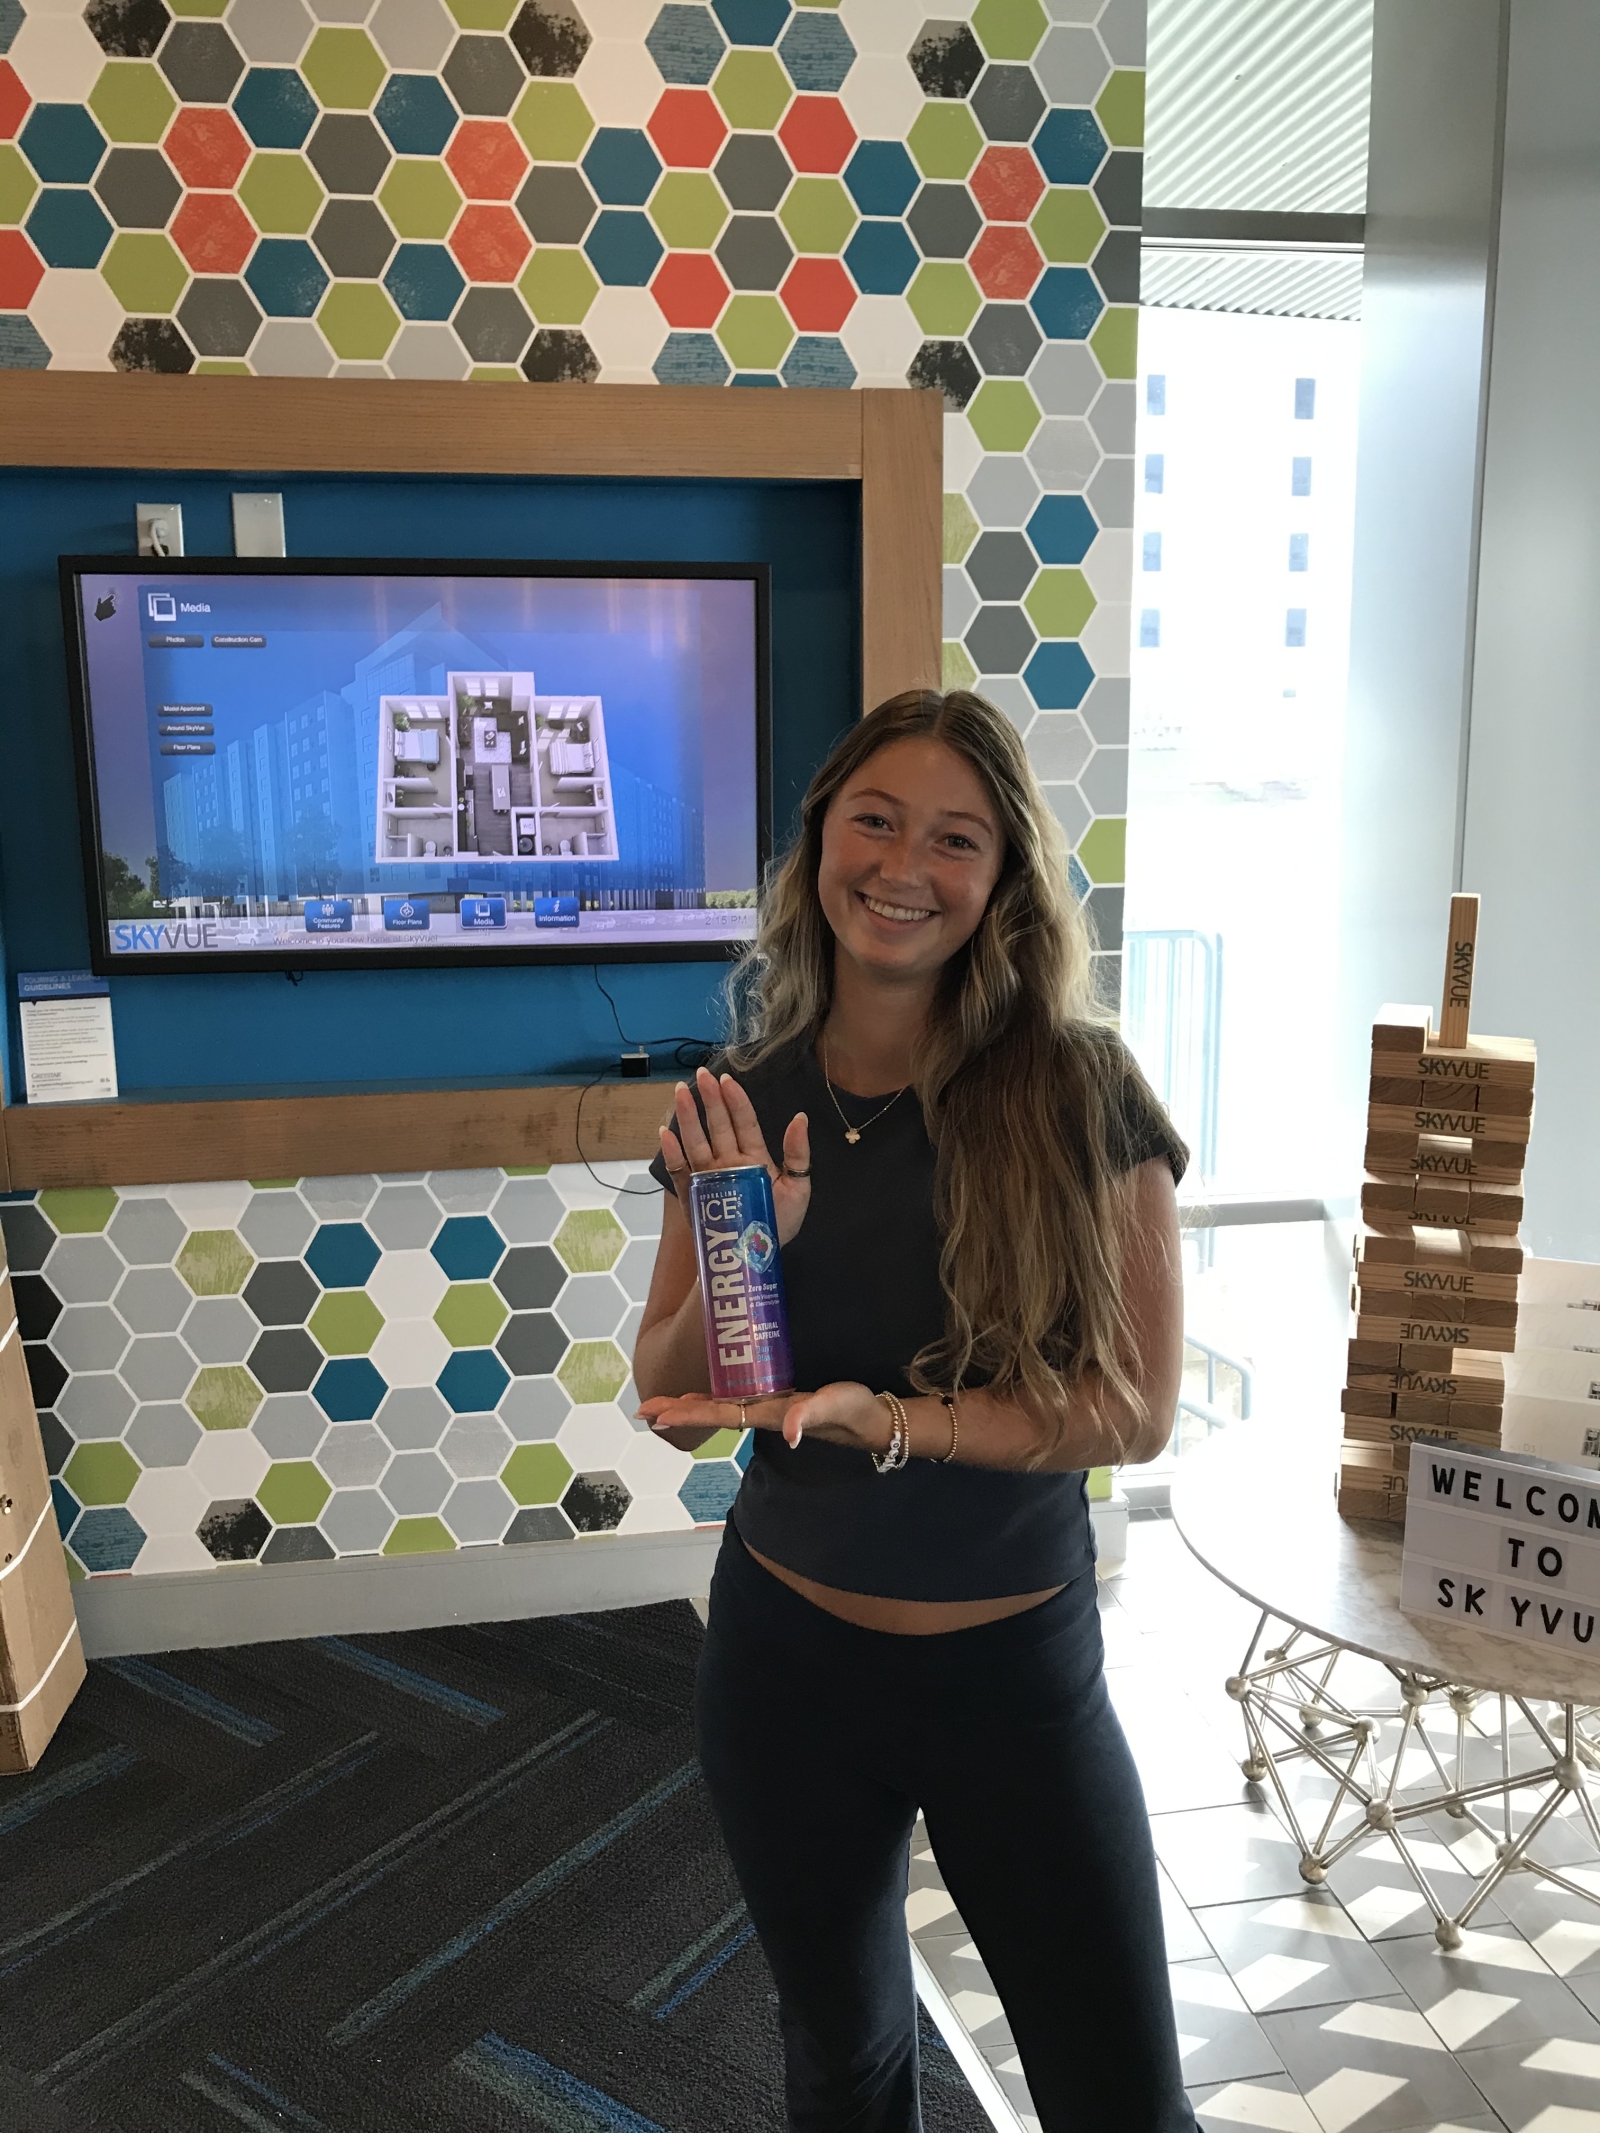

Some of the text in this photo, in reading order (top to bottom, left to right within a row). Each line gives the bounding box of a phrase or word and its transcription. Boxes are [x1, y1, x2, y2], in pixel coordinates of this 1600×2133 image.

[180, 603, 211, 613] Media
[731, 915, 747, 925] PM
[115, 924, 218, 950] SKYVUE
[273, 937, 313, 946] Welcome
[316, 936, 324, 944] to
[326, 936, 345, 945] your
[367, 934, 391, 944] home
[1449, 941, 1473, 1008] SKYVUE
[24, 982, 72, 992] GUIDELINES
[1417, 1057, 1491, 1080] SKYVUE
[1414, 1111, 1486, 1134] SKYVUE
[700, 1196, 738, 1222] ICE
[748, 1283, 778, 1292] Zero Sugar
[1403, 1271, 1474, 1293] SKYVUE
[705, 1227, 753, 1367] ENERGY
[752, 1321, 779, 1332] NATURAL
[753, 1330, 781, 1341] CAFFEINE
[1400, 1322, 1470, 1344] SKYVUE
[1388, 1373, 1459, 1395] SKYVUE
[1508, 1537, 1563, 1577] TO
